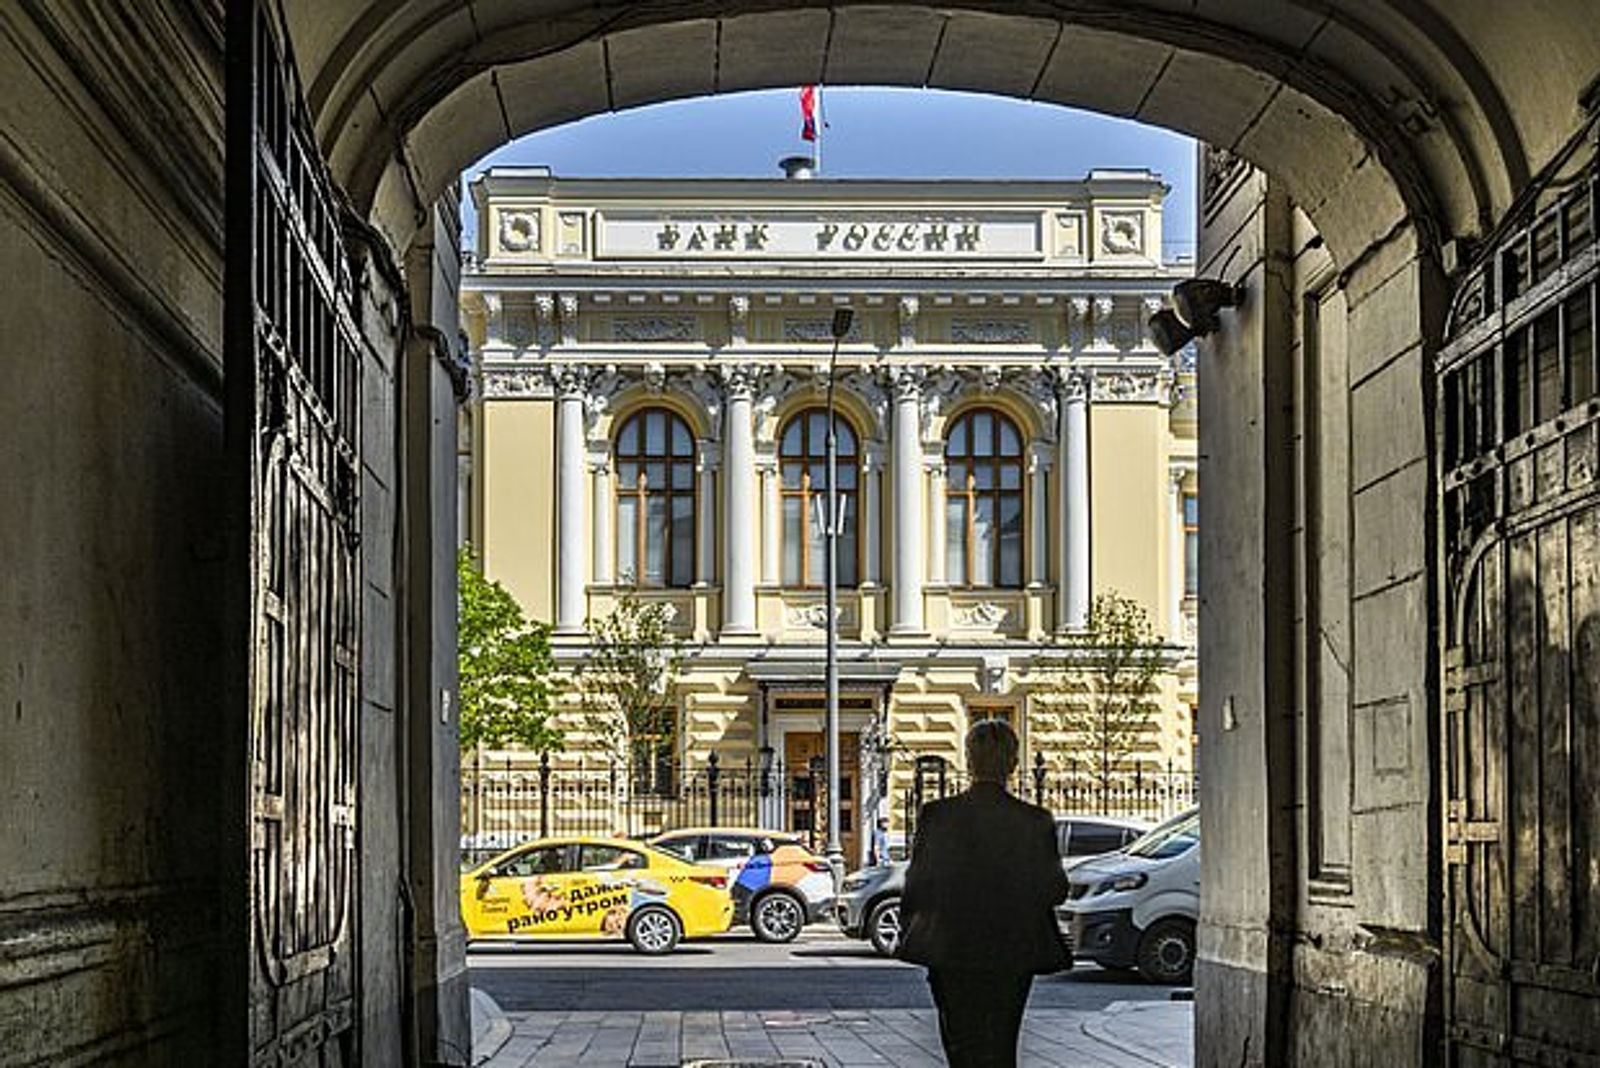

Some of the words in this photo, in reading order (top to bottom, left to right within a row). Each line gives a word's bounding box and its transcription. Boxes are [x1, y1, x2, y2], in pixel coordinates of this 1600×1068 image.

[657, 223, 769, 251] БАНК
[816, 223, 981, 251] РОССИИ
[507, 909, 557, 933] рано
[563, 894, 628, 921] утром
